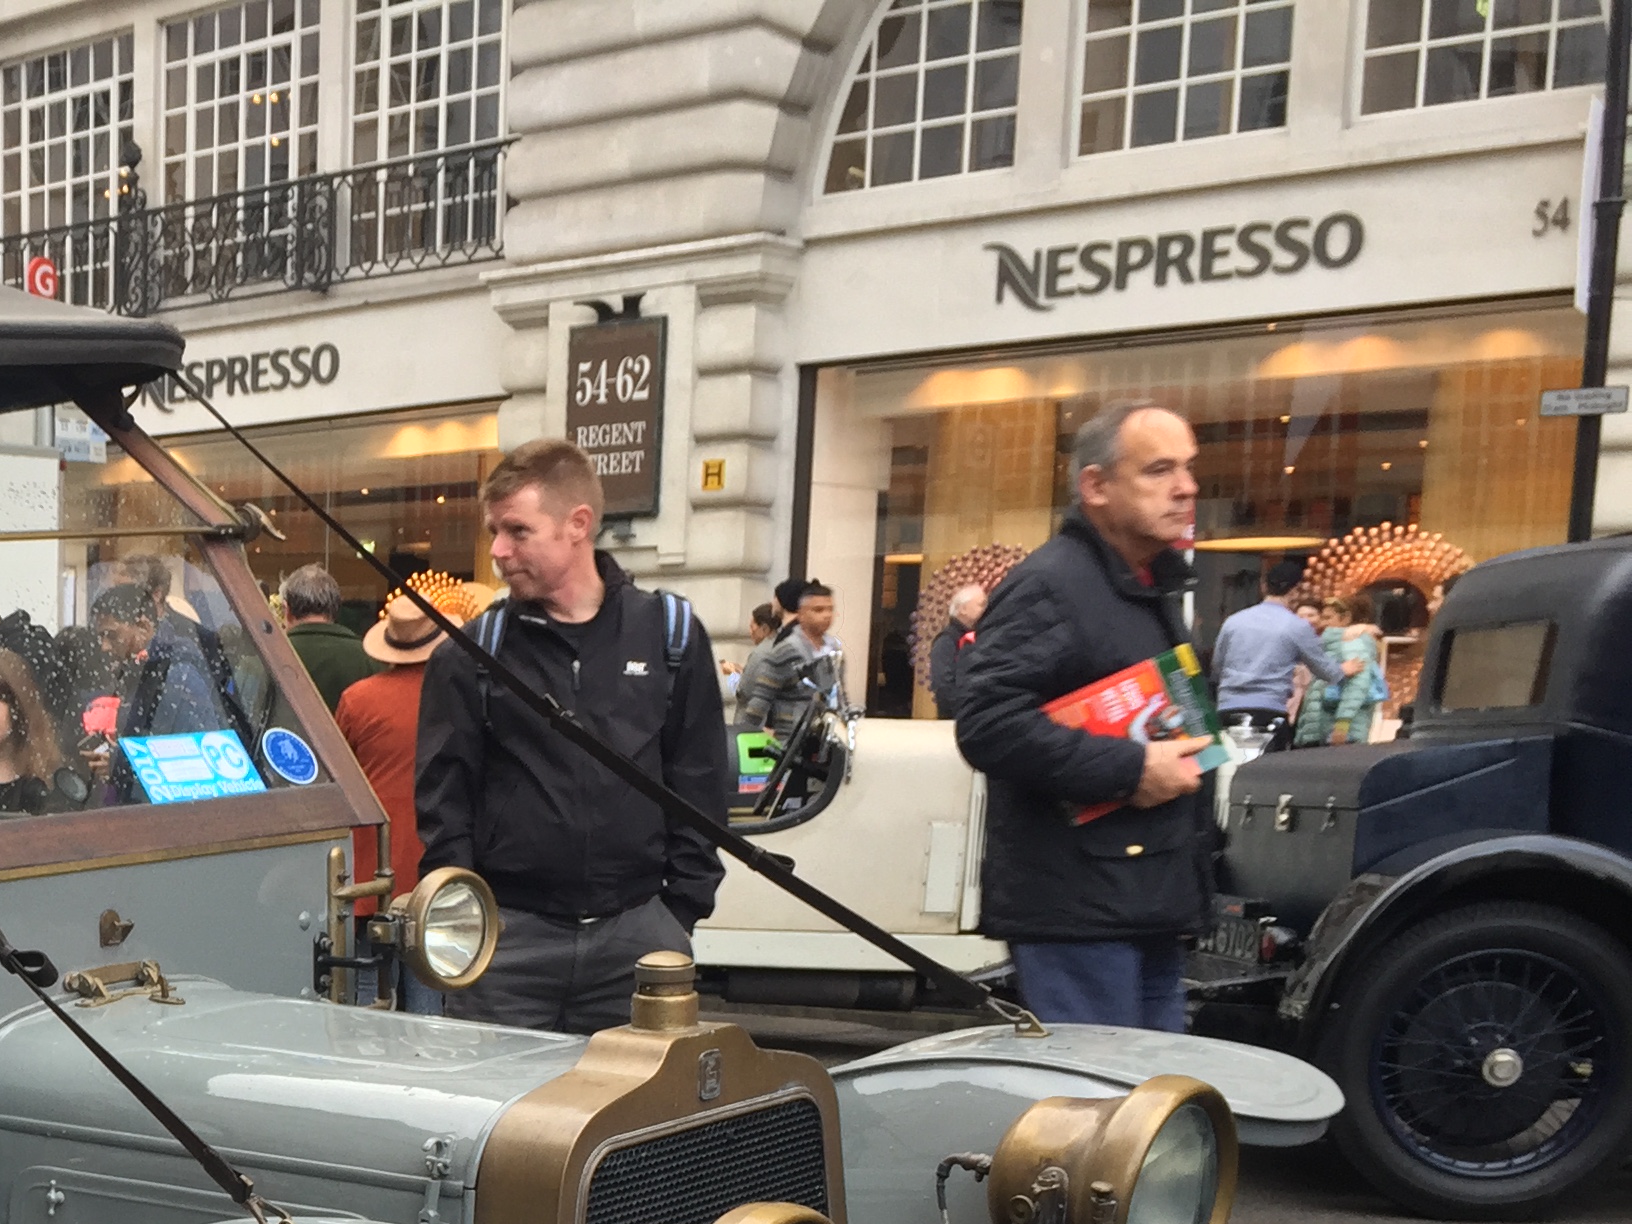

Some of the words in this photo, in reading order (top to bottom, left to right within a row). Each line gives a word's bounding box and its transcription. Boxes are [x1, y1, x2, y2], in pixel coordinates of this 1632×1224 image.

[1532, 197, 1571, 238] 54
[983, 210, 1365, 312] NESPRESSO
[576, 354, 652, 406] 54-62
[576, 421, 647, 448] REGENT
[589, 450, 645, 476] TREET
[123, 739, 174, 801] 2017
[170, 782, 218, 799] Display
